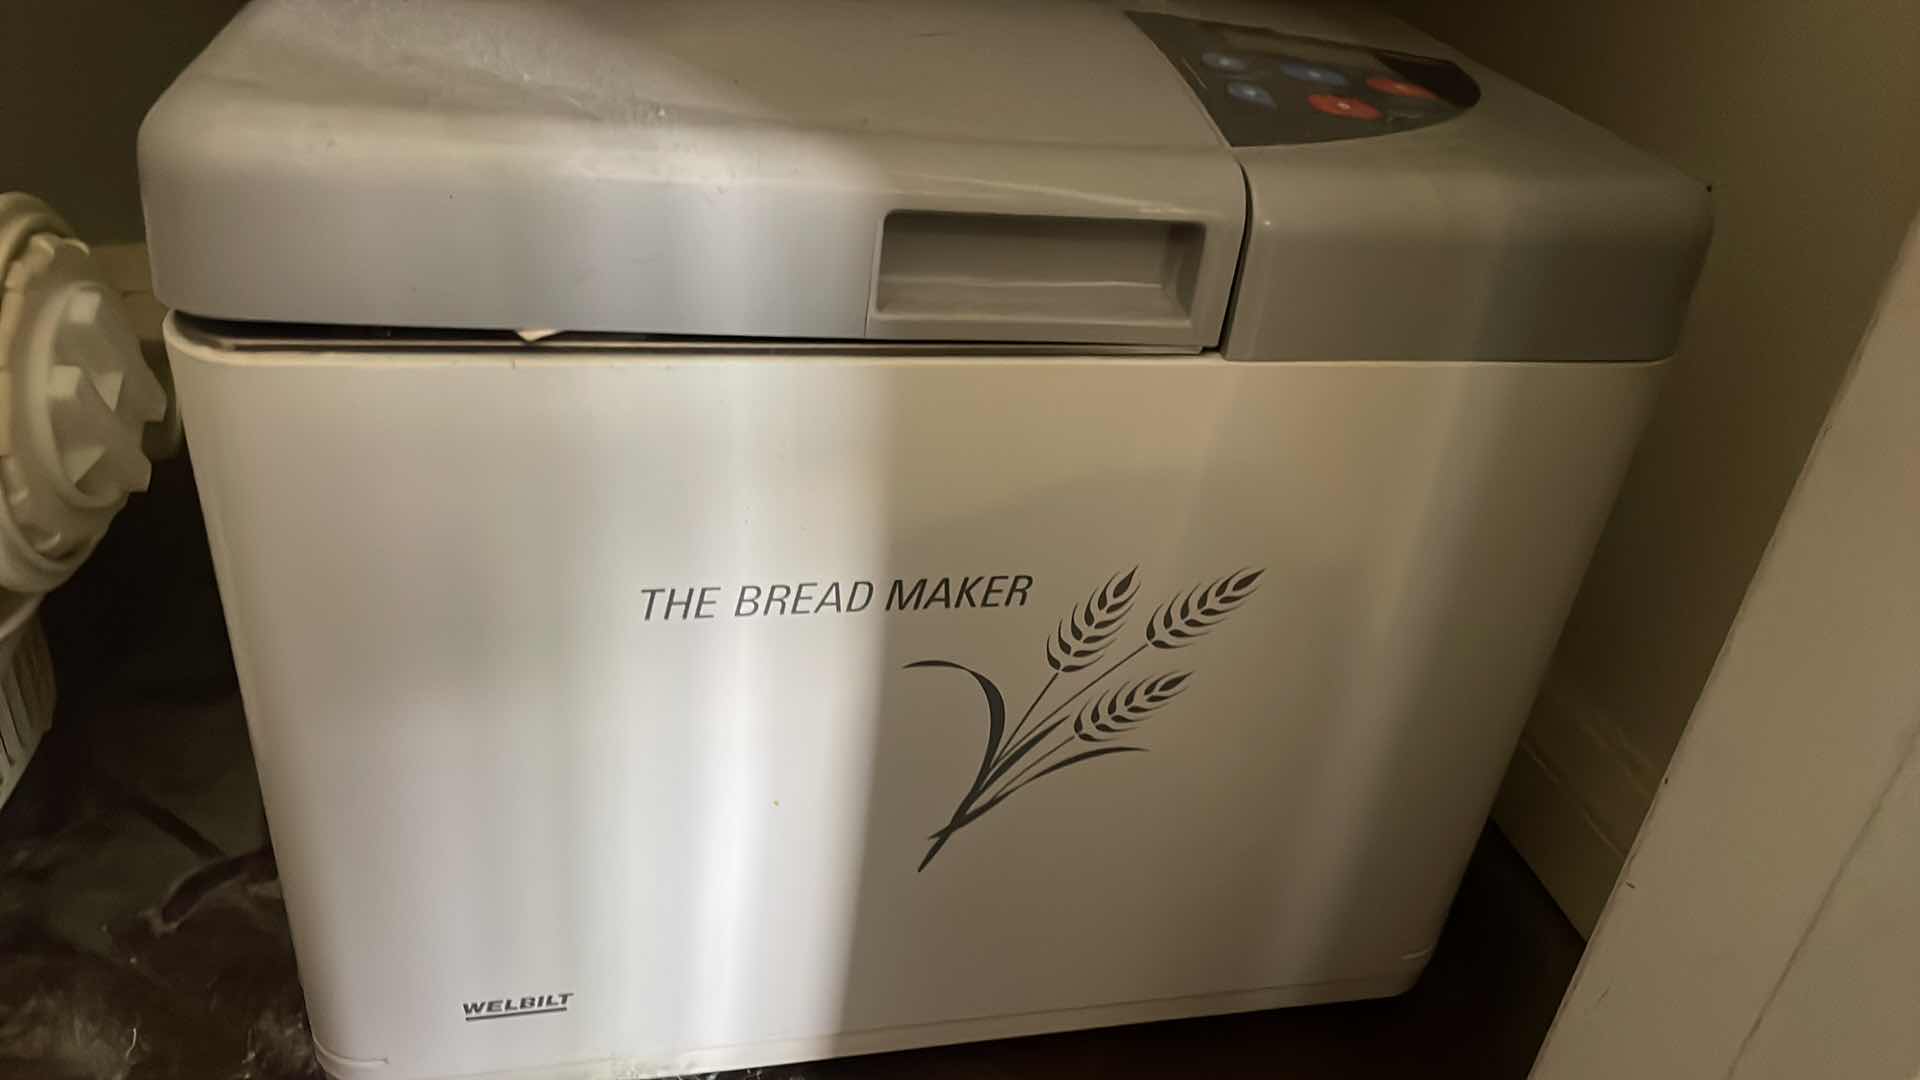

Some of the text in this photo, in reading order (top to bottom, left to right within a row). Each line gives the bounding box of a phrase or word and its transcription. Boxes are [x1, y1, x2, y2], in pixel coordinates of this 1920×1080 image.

[641, 574, 1033, 621] THE BREAD MAKER
[463, 993, 574, 1015] WELBILT
